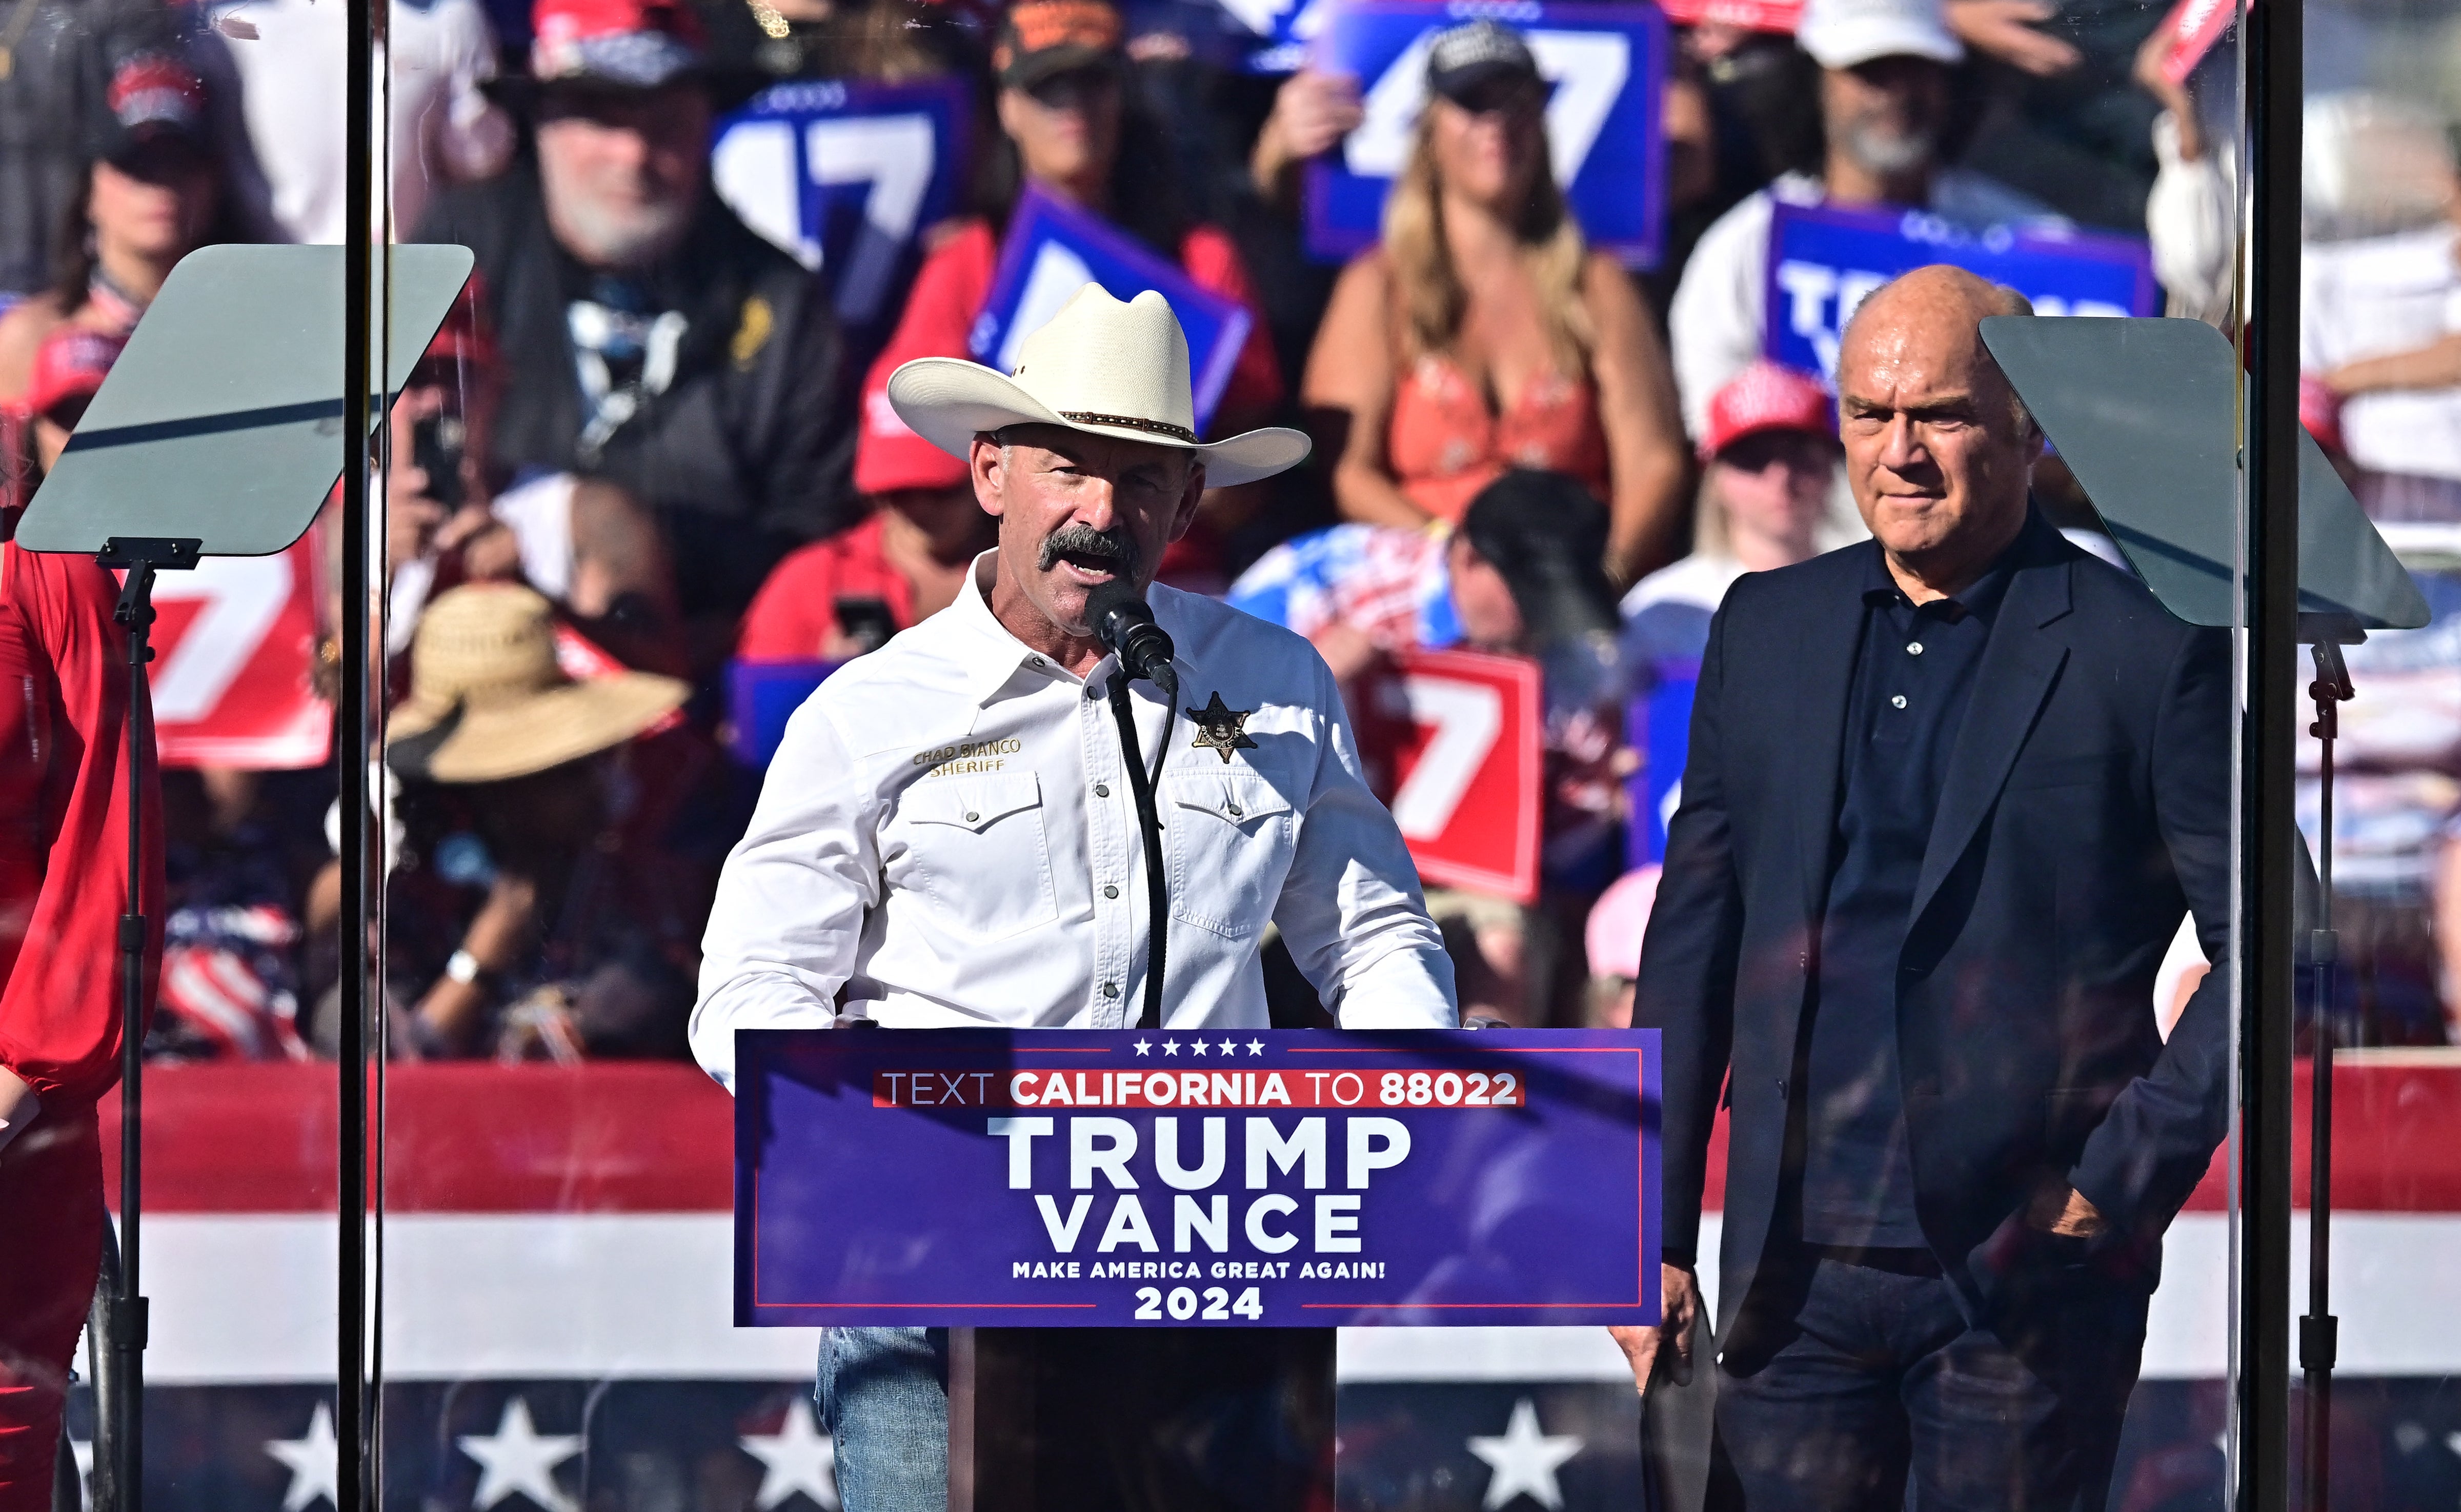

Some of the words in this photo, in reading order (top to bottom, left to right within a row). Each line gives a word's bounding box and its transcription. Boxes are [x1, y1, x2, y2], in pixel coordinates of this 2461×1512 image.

[1200, 724, 1226, 748] RIVERSIDE
[913, 747, 956, 765] CHAD
[960, 738, 1021, 758] BIANCO
[930, 759, 1004, 778] SHERIFF
[882, 1073, 994, 1105] TEXT
[1010, 1072, 1292, 1105] CALIFORNIA
[1305, 1072, 1364, 1105] TO
[1379, 1072, 1517, 1106] 88022
[987, 1116, 1411, 1191] TRUMP
[1034, 1194, 1361, 1254] VANCE
[1013, 1262, 1080, 1278] MAKE
[1090, 1261, 1202, 1279] AMERICA
[1211, 1261, 1290, 1279] GREAT
[1299, 1262, 1385, 1279] AGAIN!
[1135, 1286, 1263, 1321] 2024
